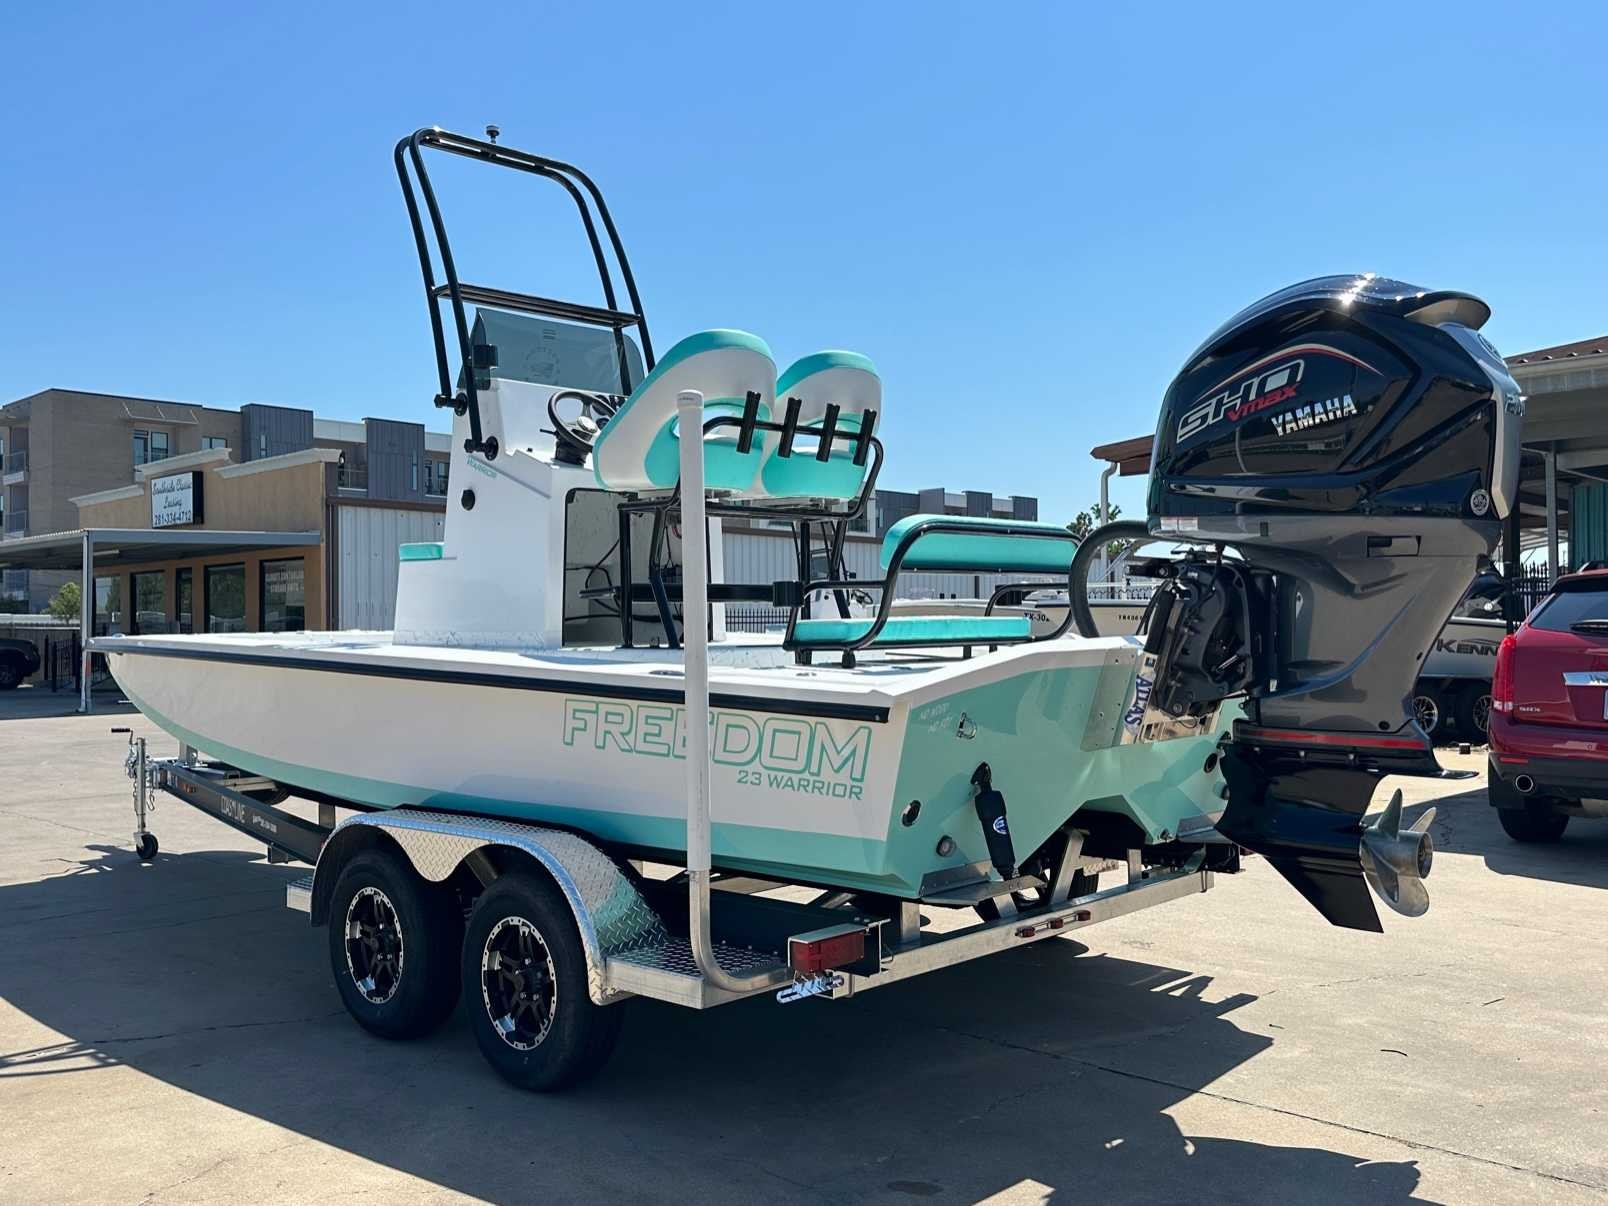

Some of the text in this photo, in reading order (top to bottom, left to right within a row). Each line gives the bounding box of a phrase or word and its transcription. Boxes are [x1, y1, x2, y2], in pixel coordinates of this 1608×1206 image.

[1177, 359, 1304, 444] SHO
[1271, 394, 1358, 437] YAMAHA
[1436, 638, 1498, 656] KENN
[1125, 674, 1153, 725] ATLAS
[736, 769, 863, 800] 23 WARRIOR
